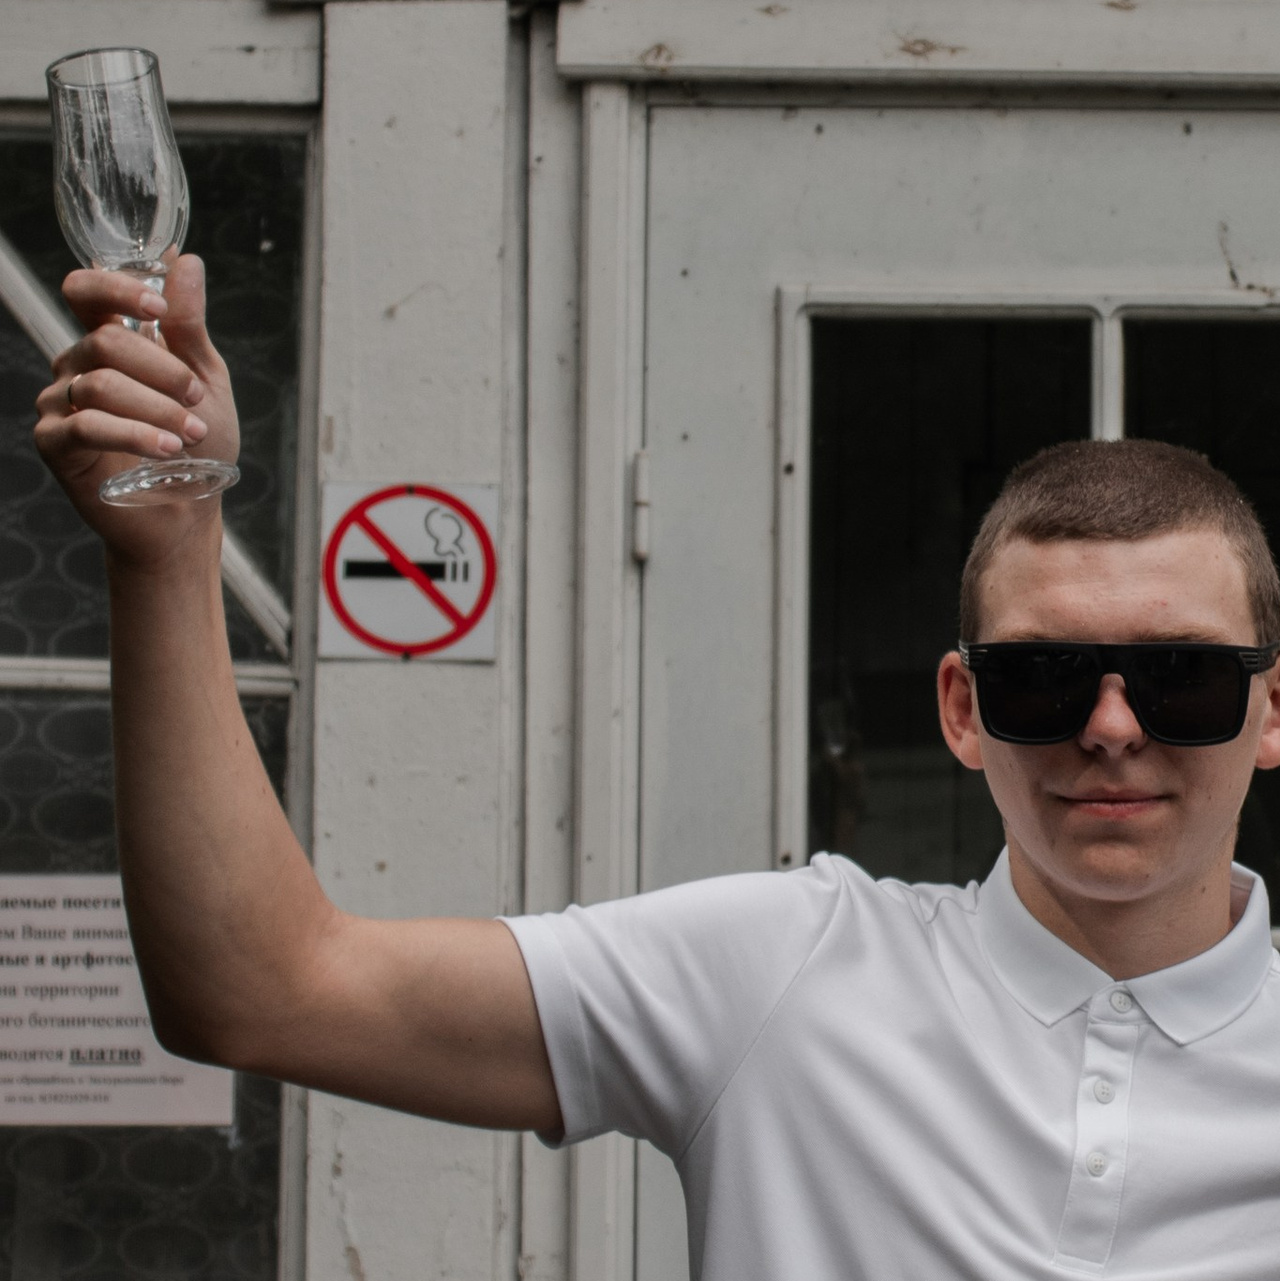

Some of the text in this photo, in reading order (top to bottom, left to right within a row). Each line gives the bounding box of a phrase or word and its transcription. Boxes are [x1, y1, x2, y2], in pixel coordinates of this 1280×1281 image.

[21, 924, 66, 940] Ваше
[35, 954, 44, 967] и
[23, 985, 120, 1001] территории
